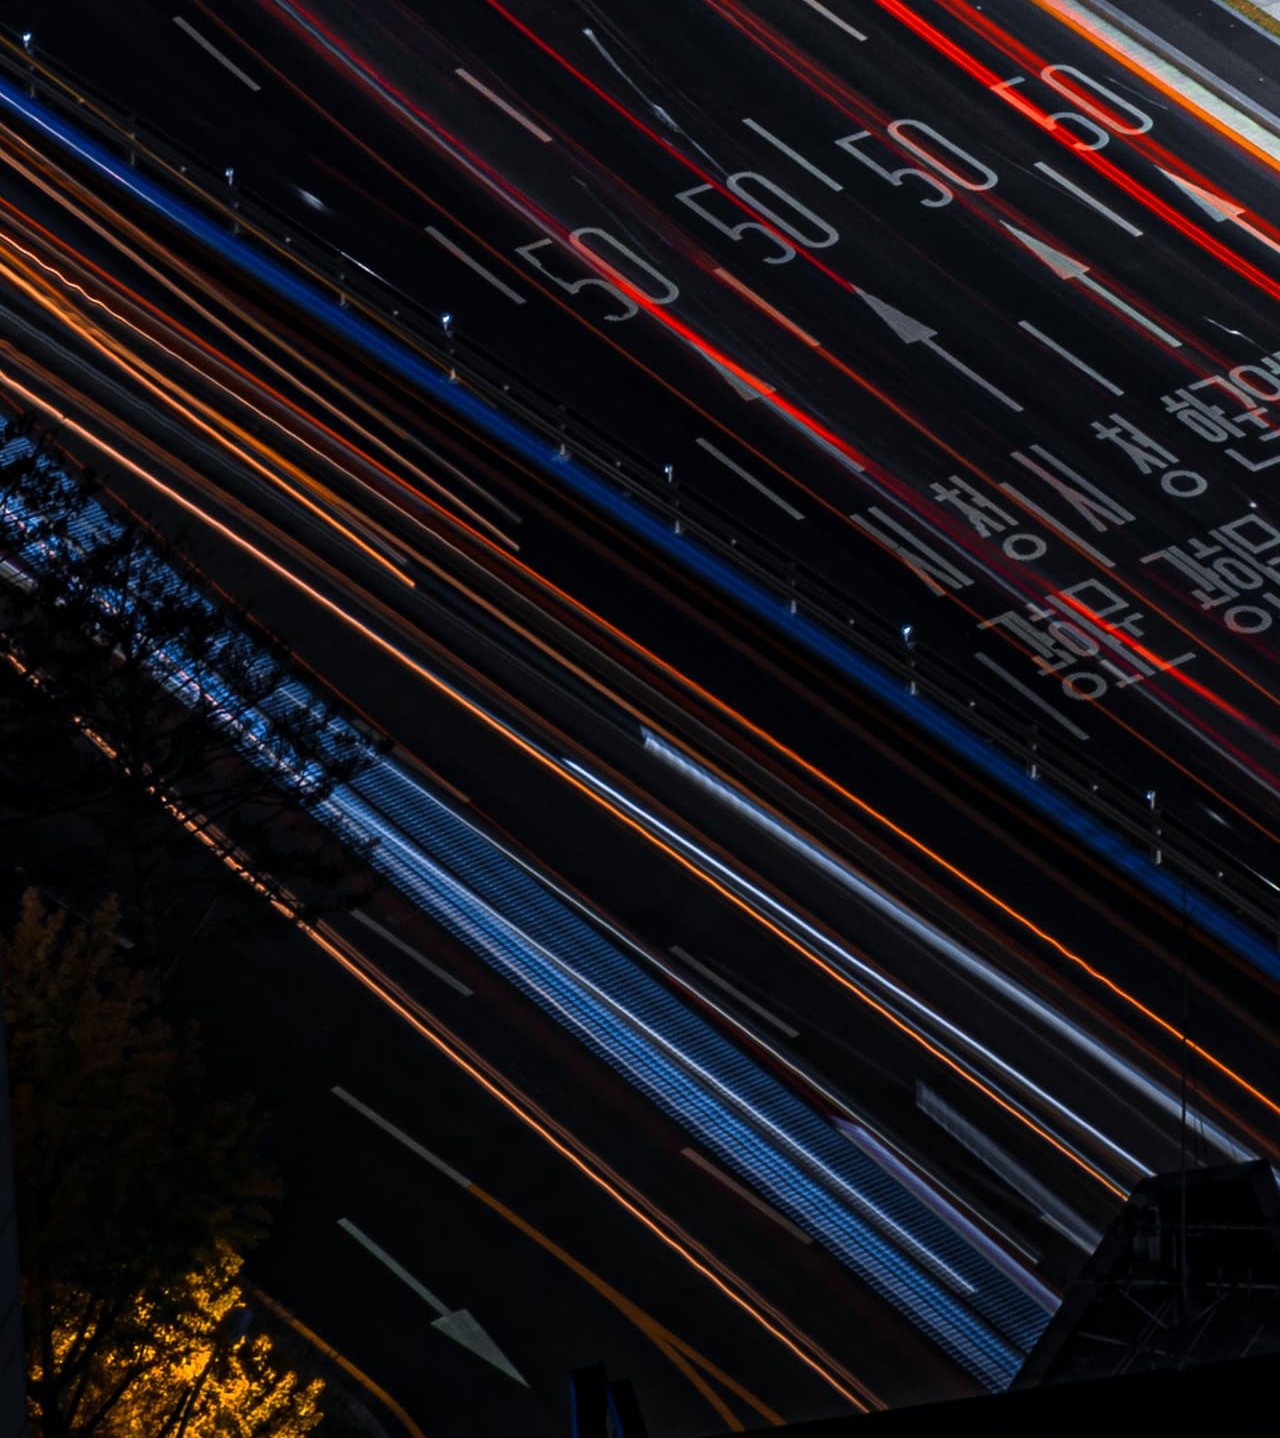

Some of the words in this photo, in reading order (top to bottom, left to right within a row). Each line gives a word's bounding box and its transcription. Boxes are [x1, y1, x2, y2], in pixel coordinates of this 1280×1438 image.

[990, 64, 1154, 151] 50
[834, 118, 998, 208] 50
[675, 170, 840, 265] 50
[515, 227, 679, 323] 50
[1010, 413, 1208, 533] 시청
[848, 474, 1048, 597] 시청
[977, 578, 1197, 701] 광화문
